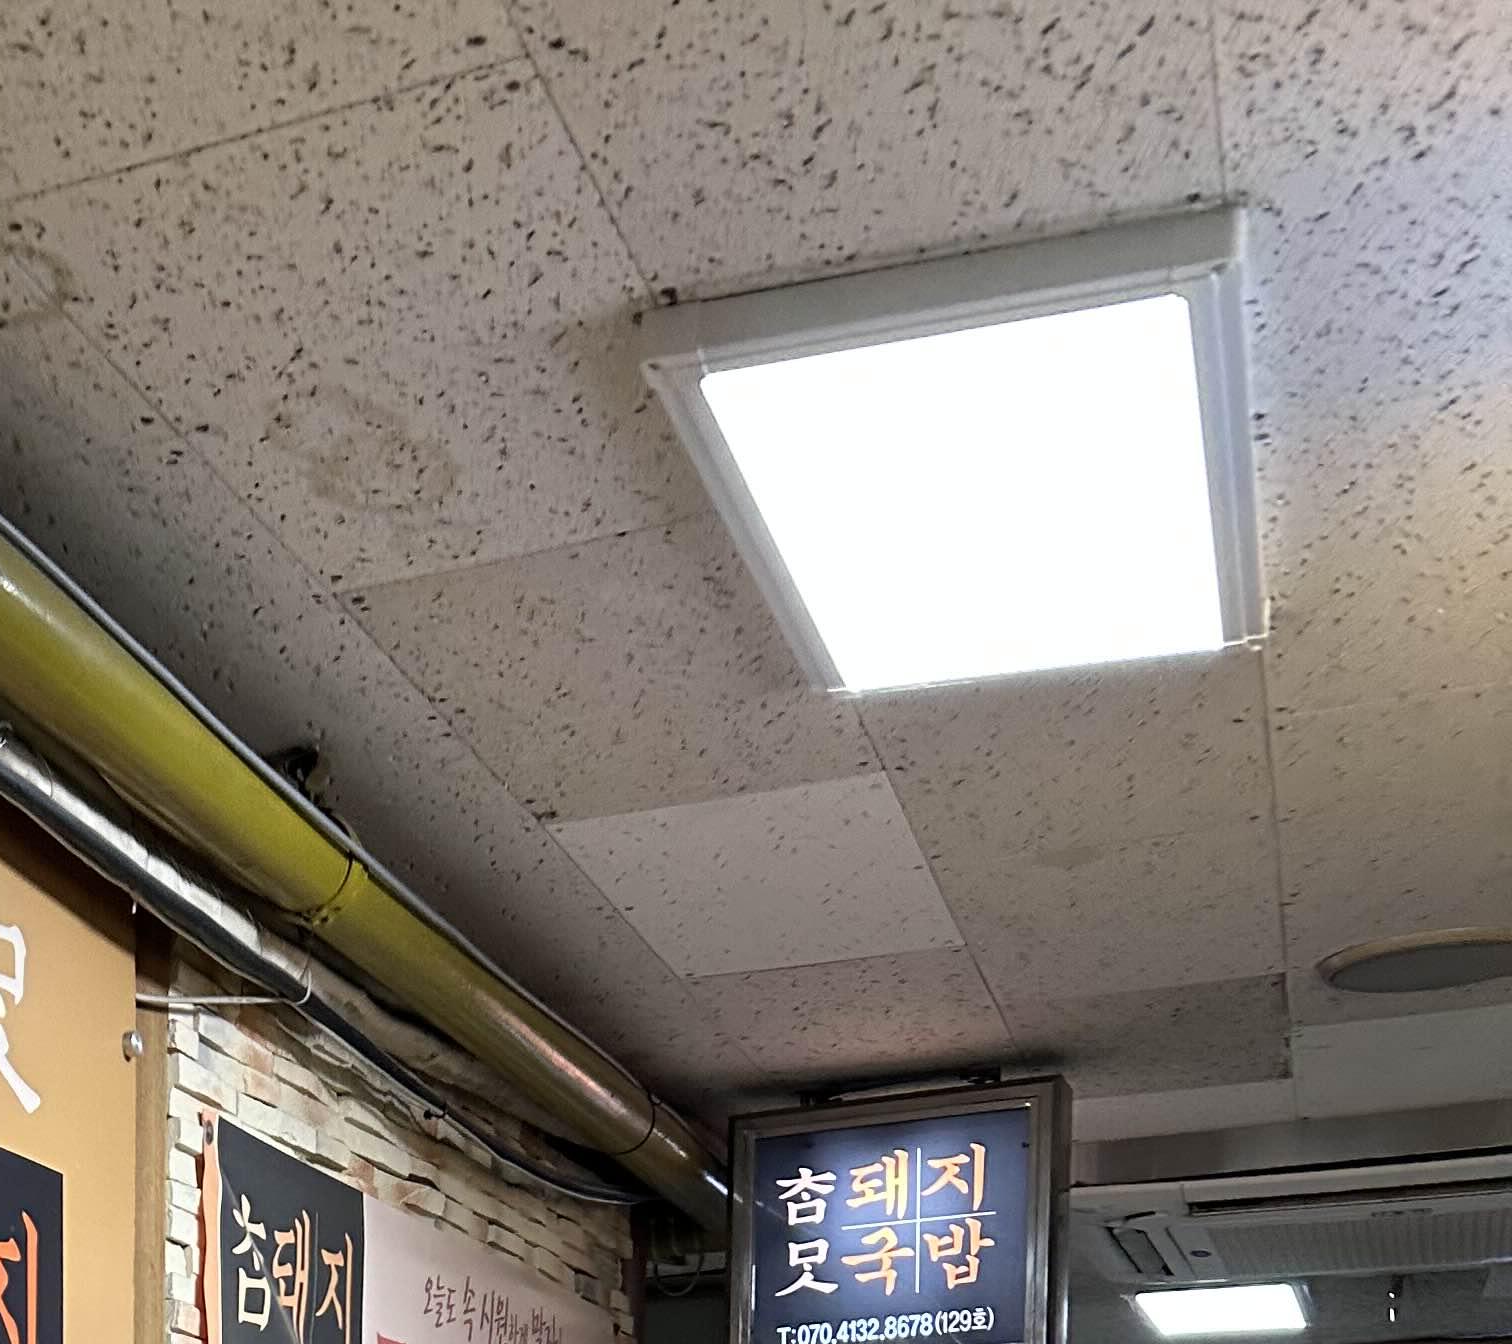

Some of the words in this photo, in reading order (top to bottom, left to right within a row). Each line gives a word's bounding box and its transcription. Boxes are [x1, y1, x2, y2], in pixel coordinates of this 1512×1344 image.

[846, 1142, 985, 1220] 돼지
[841, 1217, 995, 1296] 국밥
[424, 1274, 456, 1328] 오늘도
[463, 1275, 476, 1342] 속
